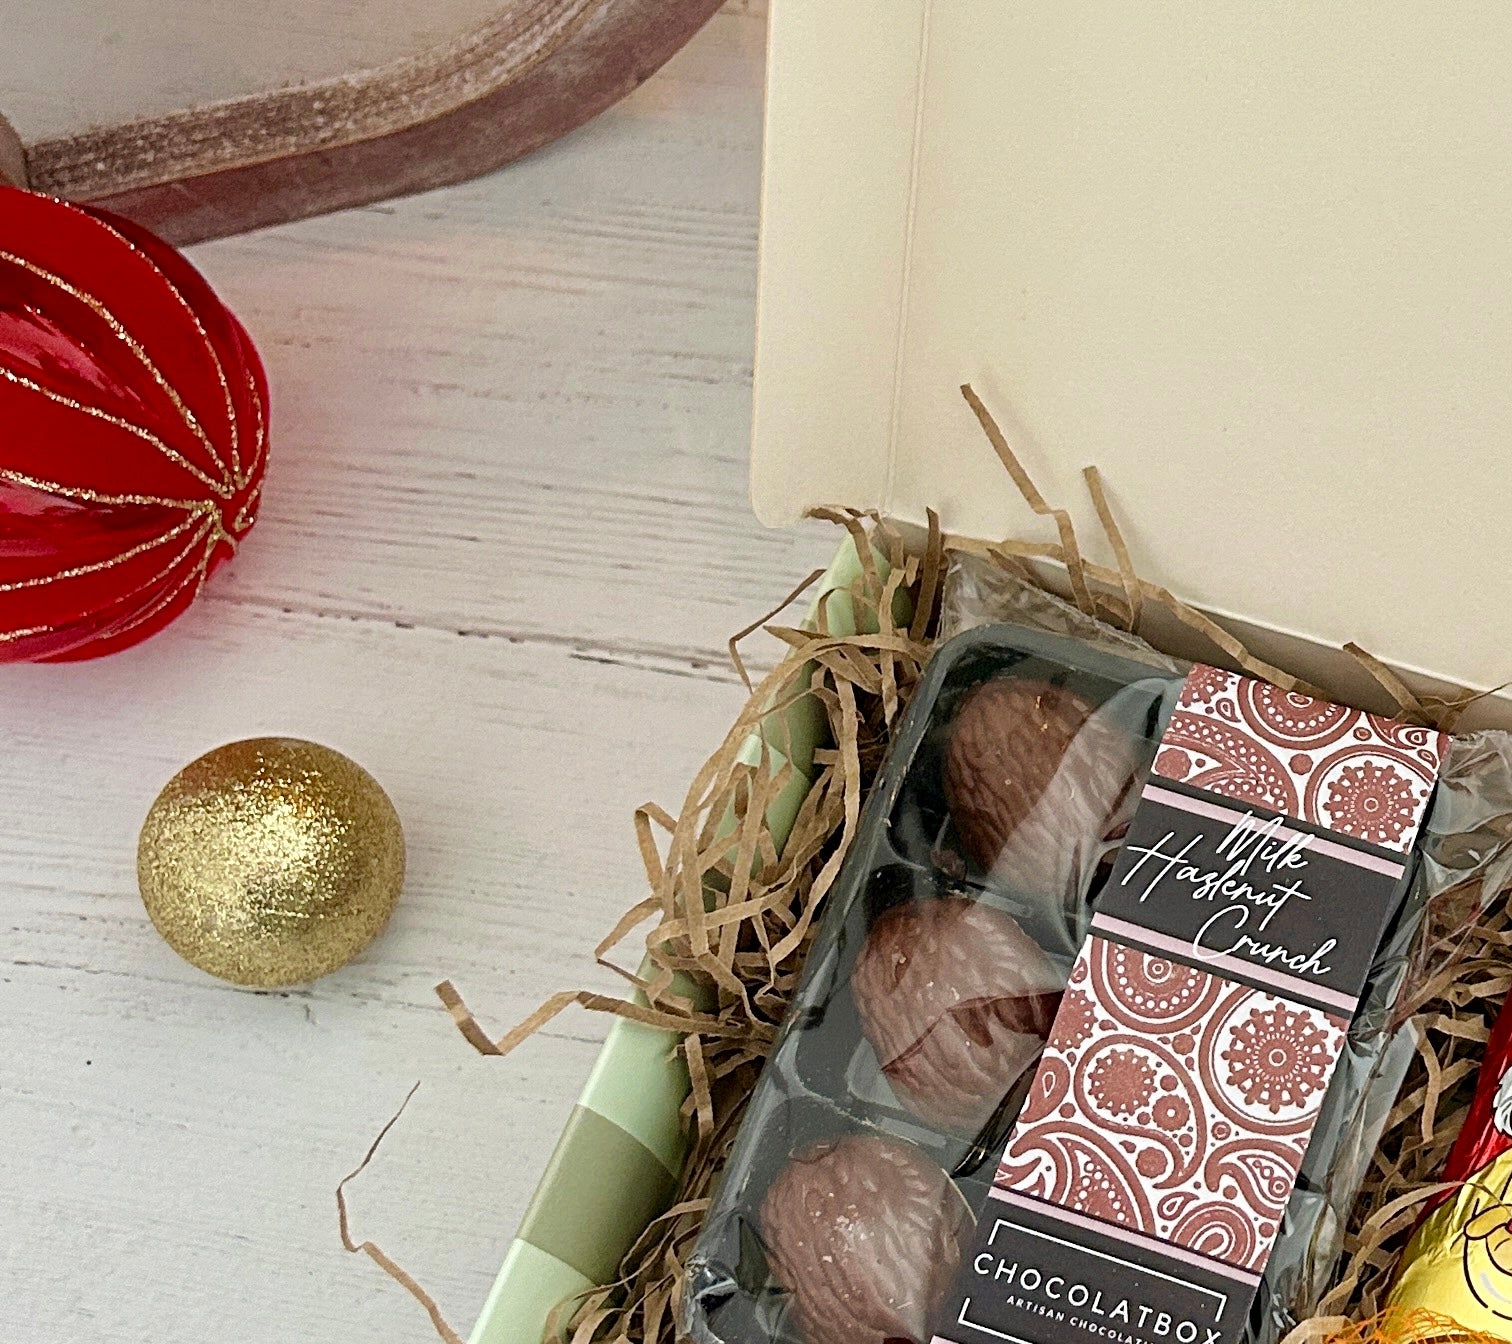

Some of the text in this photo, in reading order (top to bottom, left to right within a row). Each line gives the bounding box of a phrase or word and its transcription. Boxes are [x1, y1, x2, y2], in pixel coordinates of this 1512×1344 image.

[1215, 810, 1315, 876] Milk
[1192, 904, 1337, 975] Crunch
[1006, 1295, 1064, 1322] ARTISAN
